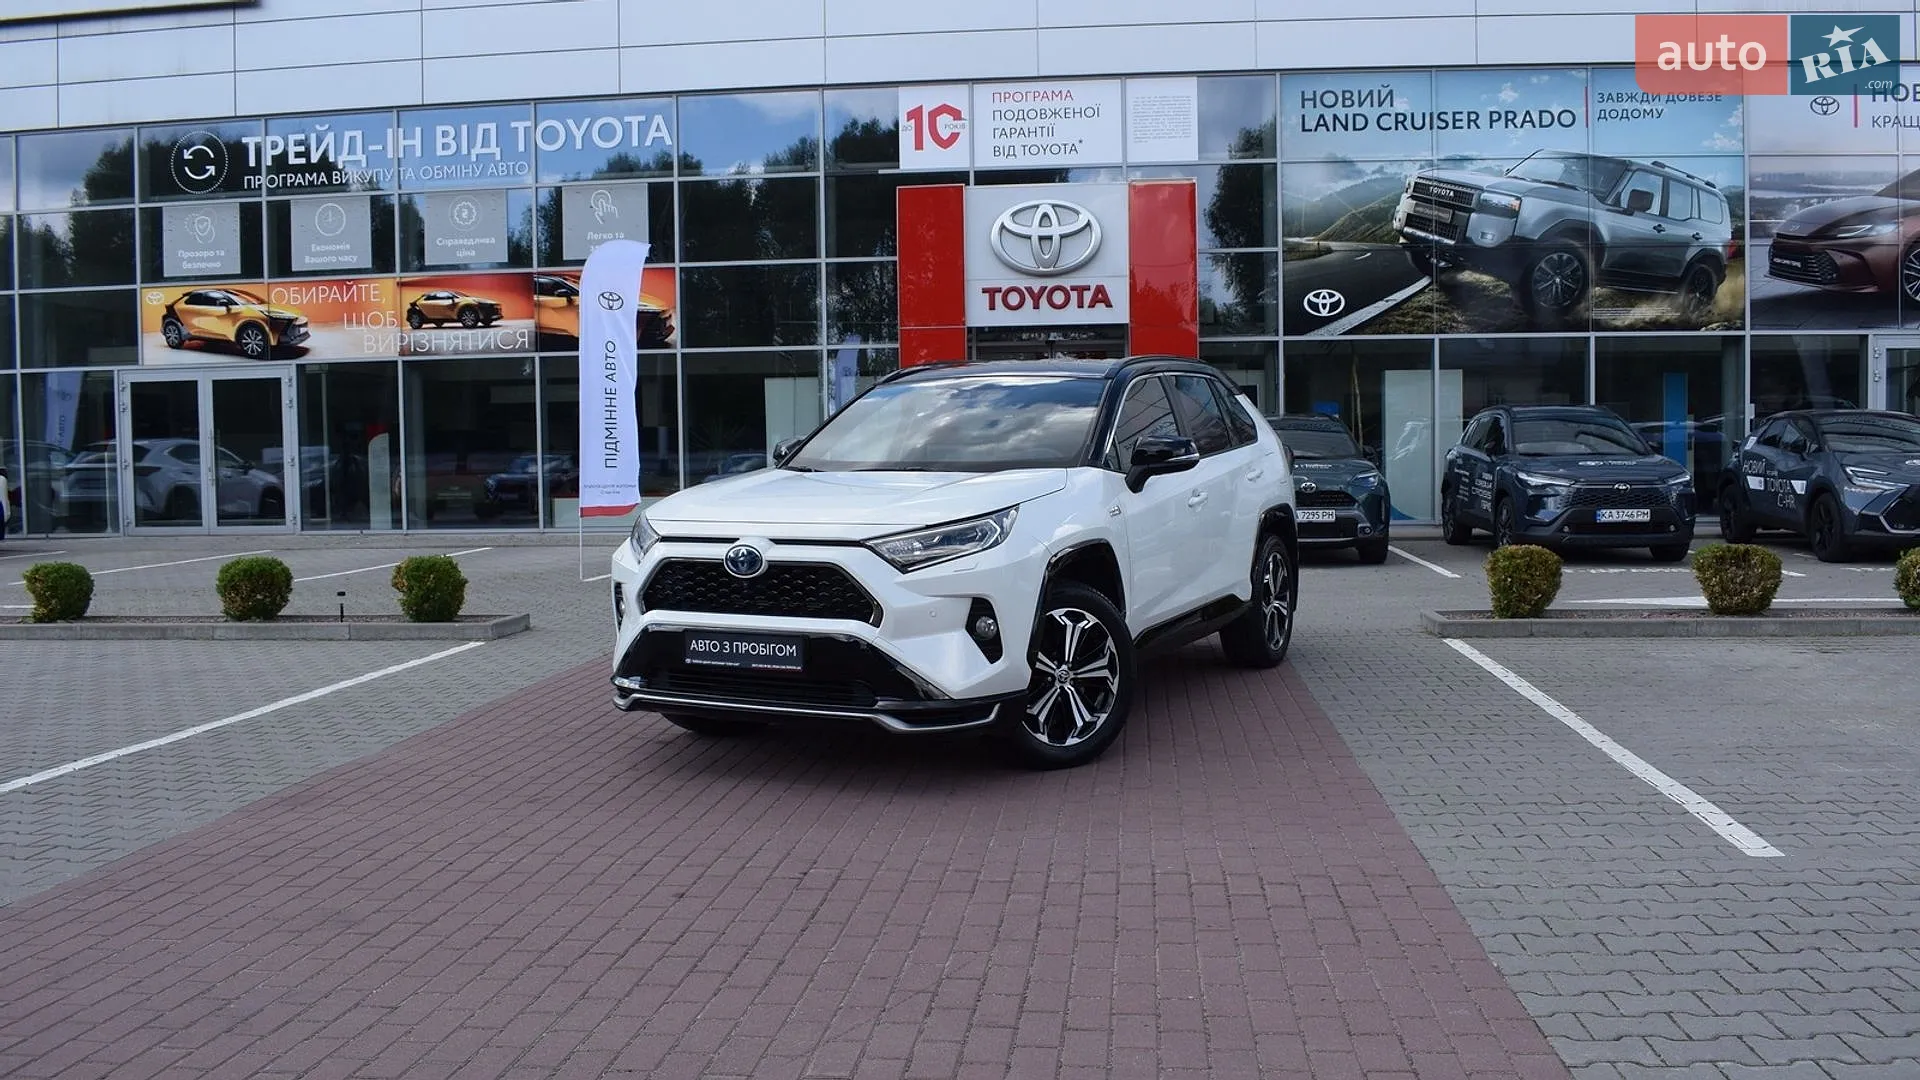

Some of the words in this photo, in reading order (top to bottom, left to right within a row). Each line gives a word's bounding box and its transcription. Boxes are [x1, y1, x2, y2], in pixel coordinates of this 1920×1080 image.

[992, 89, 1074, 103] ПРОГРАМА
[1301, 84, 1394, 109] НОВИЙ
[1597, 92, 1661, 105] ЗАВЖДИ
[1665, 91, 1722, 104] ДОВЕЗЕ
[992, 102, 1101, 122] ПОДОВЖЕНОЇ
[1301, 113, 1369, 132] LAND
[1376, 110, 1480, 131] CRUISER
[1489, 109, 1576, 129] PRADO
[1597, 108, 1665, 121] ДОДОМУ
[993, 122, 1055, 139] ГАРАНТІЇ
[241, 124, 422, 169] ТРЕЙД-ІН
[436, 121, 501, 161] ВІД
[511, 114, 673, 154] TOYOTA
[993, 146, 1017, 159] ВІД
[244, 174, 328, 190] ПРОГРАМА
[333, 169, 394, 187] ВИКУПУ
[398, 167, 415, 181] ТА
[419, 163, 484, 180] ОБМІНУ
[487, 161, 529, 176] АВТО
[981, 285, 1113, 311] TOYOTA
[343, 311, 396, 331] ЩОБ
[364, 328, 529, 353] ВИРІЗНЯТИСЯ
[605, 341, 617, 383] АВТО
[605, 387, 619, 468] ПІДМІННЕ
[690, 639, 720, 652] АВТО
[723, 641, 730, 653] З
[733, 642, 797, 657] ПРОБІГОМ
